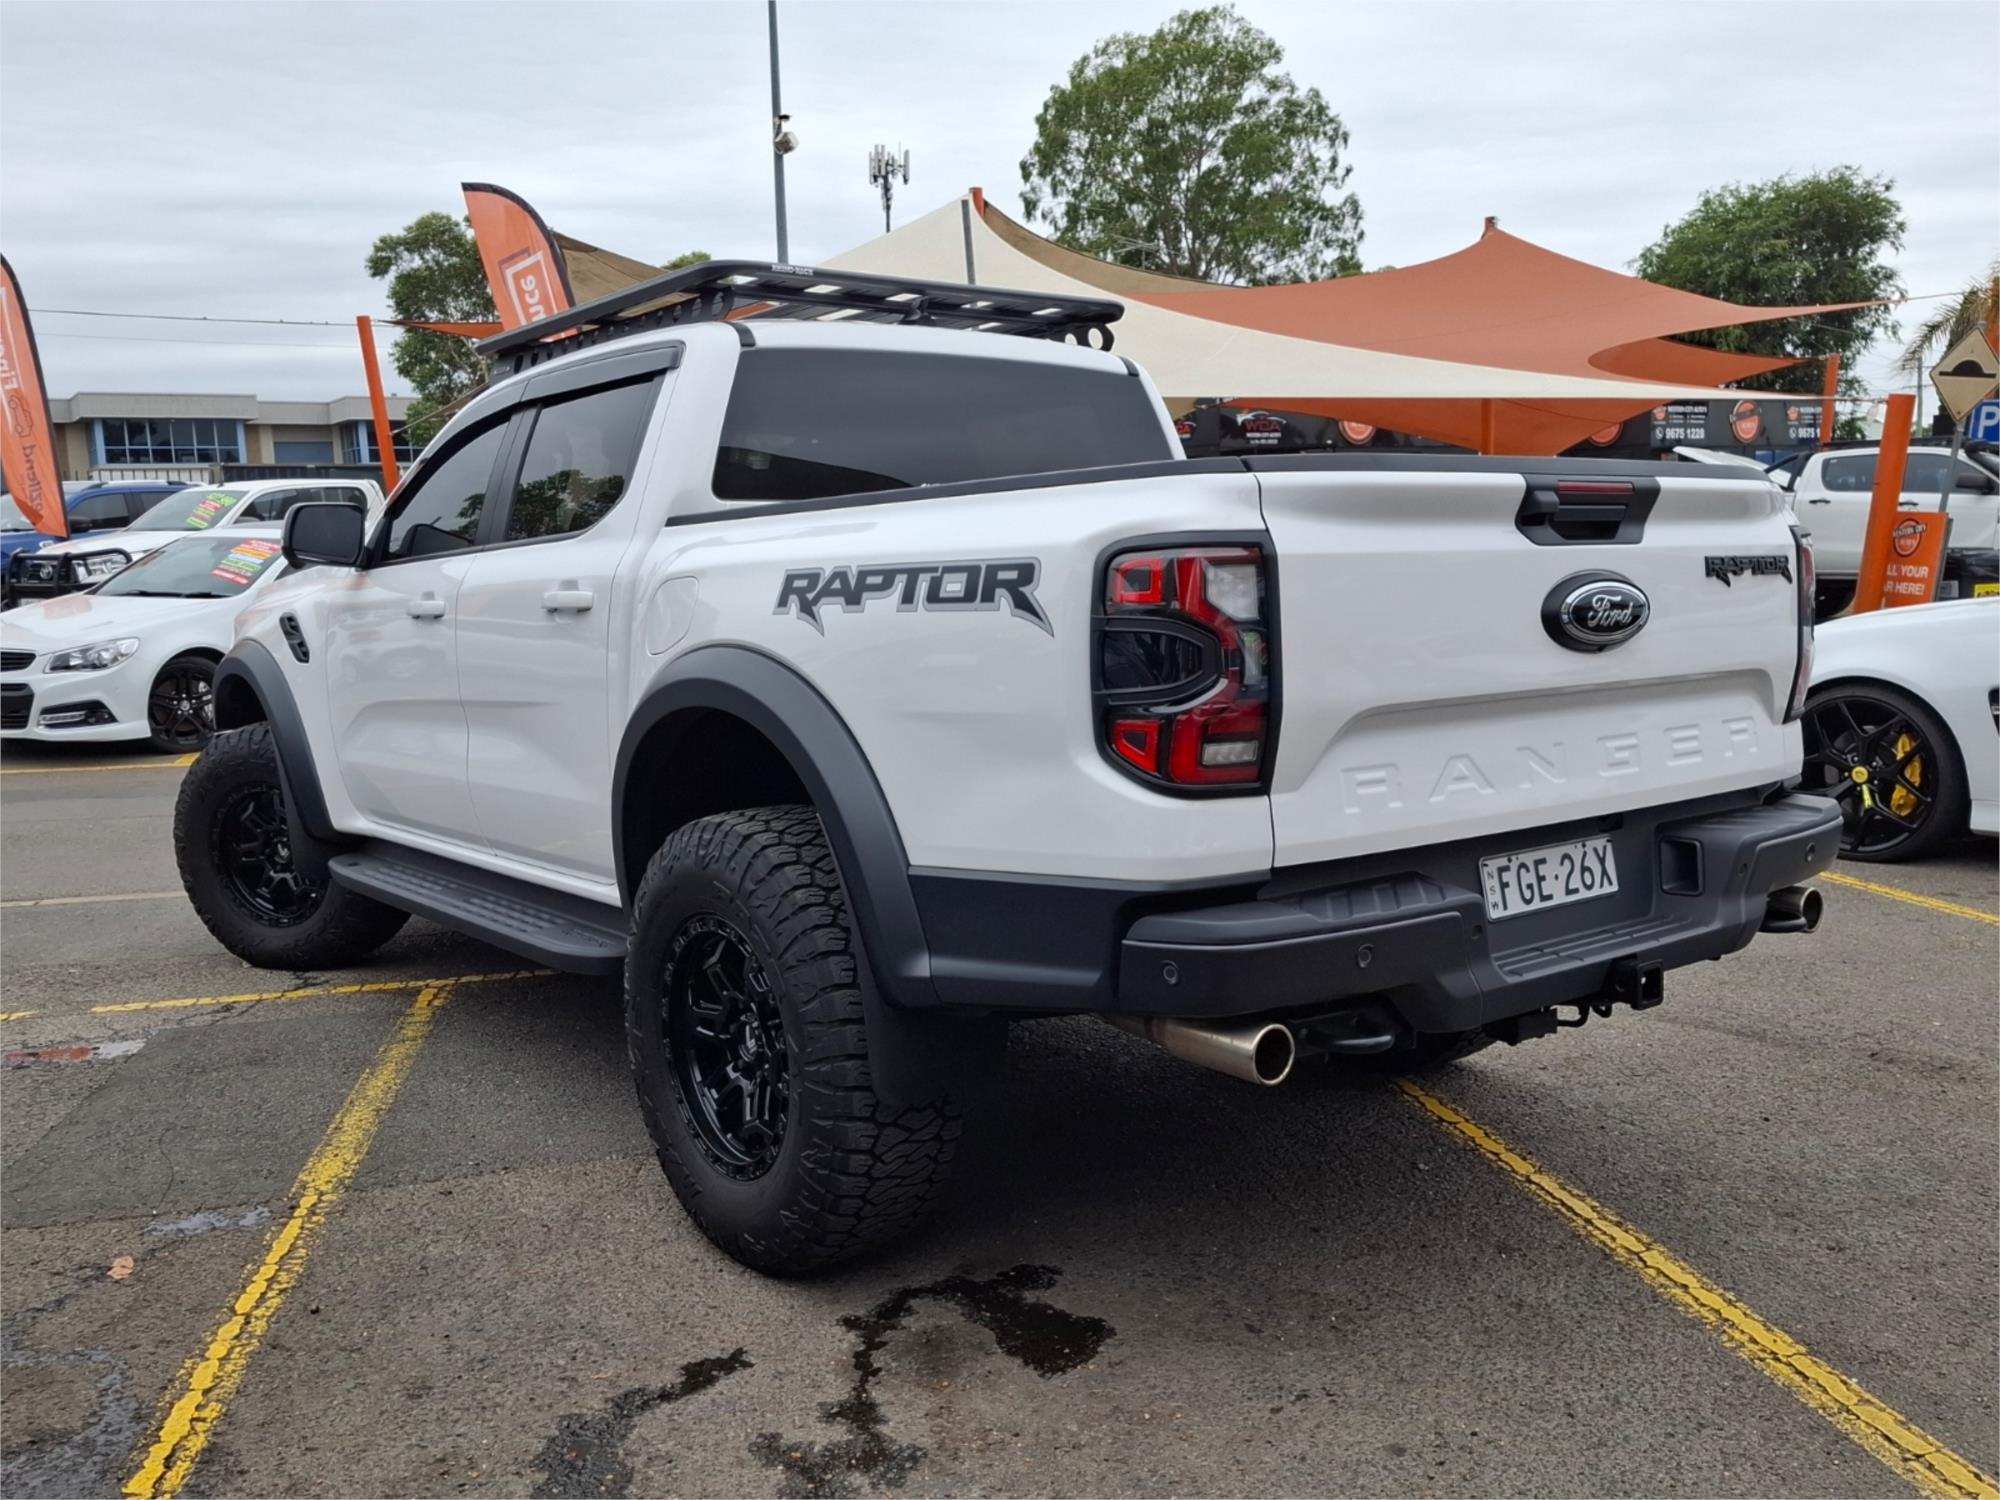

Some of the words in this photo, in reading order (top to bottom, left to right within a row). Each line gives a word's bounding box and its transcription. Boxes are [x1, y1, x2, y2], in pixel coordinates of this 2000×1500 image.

[1977, 405, 1999, 439] P
[1704, 555, 1793, 588] RAPTOR
[1895, 581, 1925, 596] HERE!
[1900, 564, 1929, 579] YOUR
[772, 556, 1055, 638] RAPTOR
[1587, 593, 1633, 628] Ford
[1339, 715, 1758, 815] RANGER
